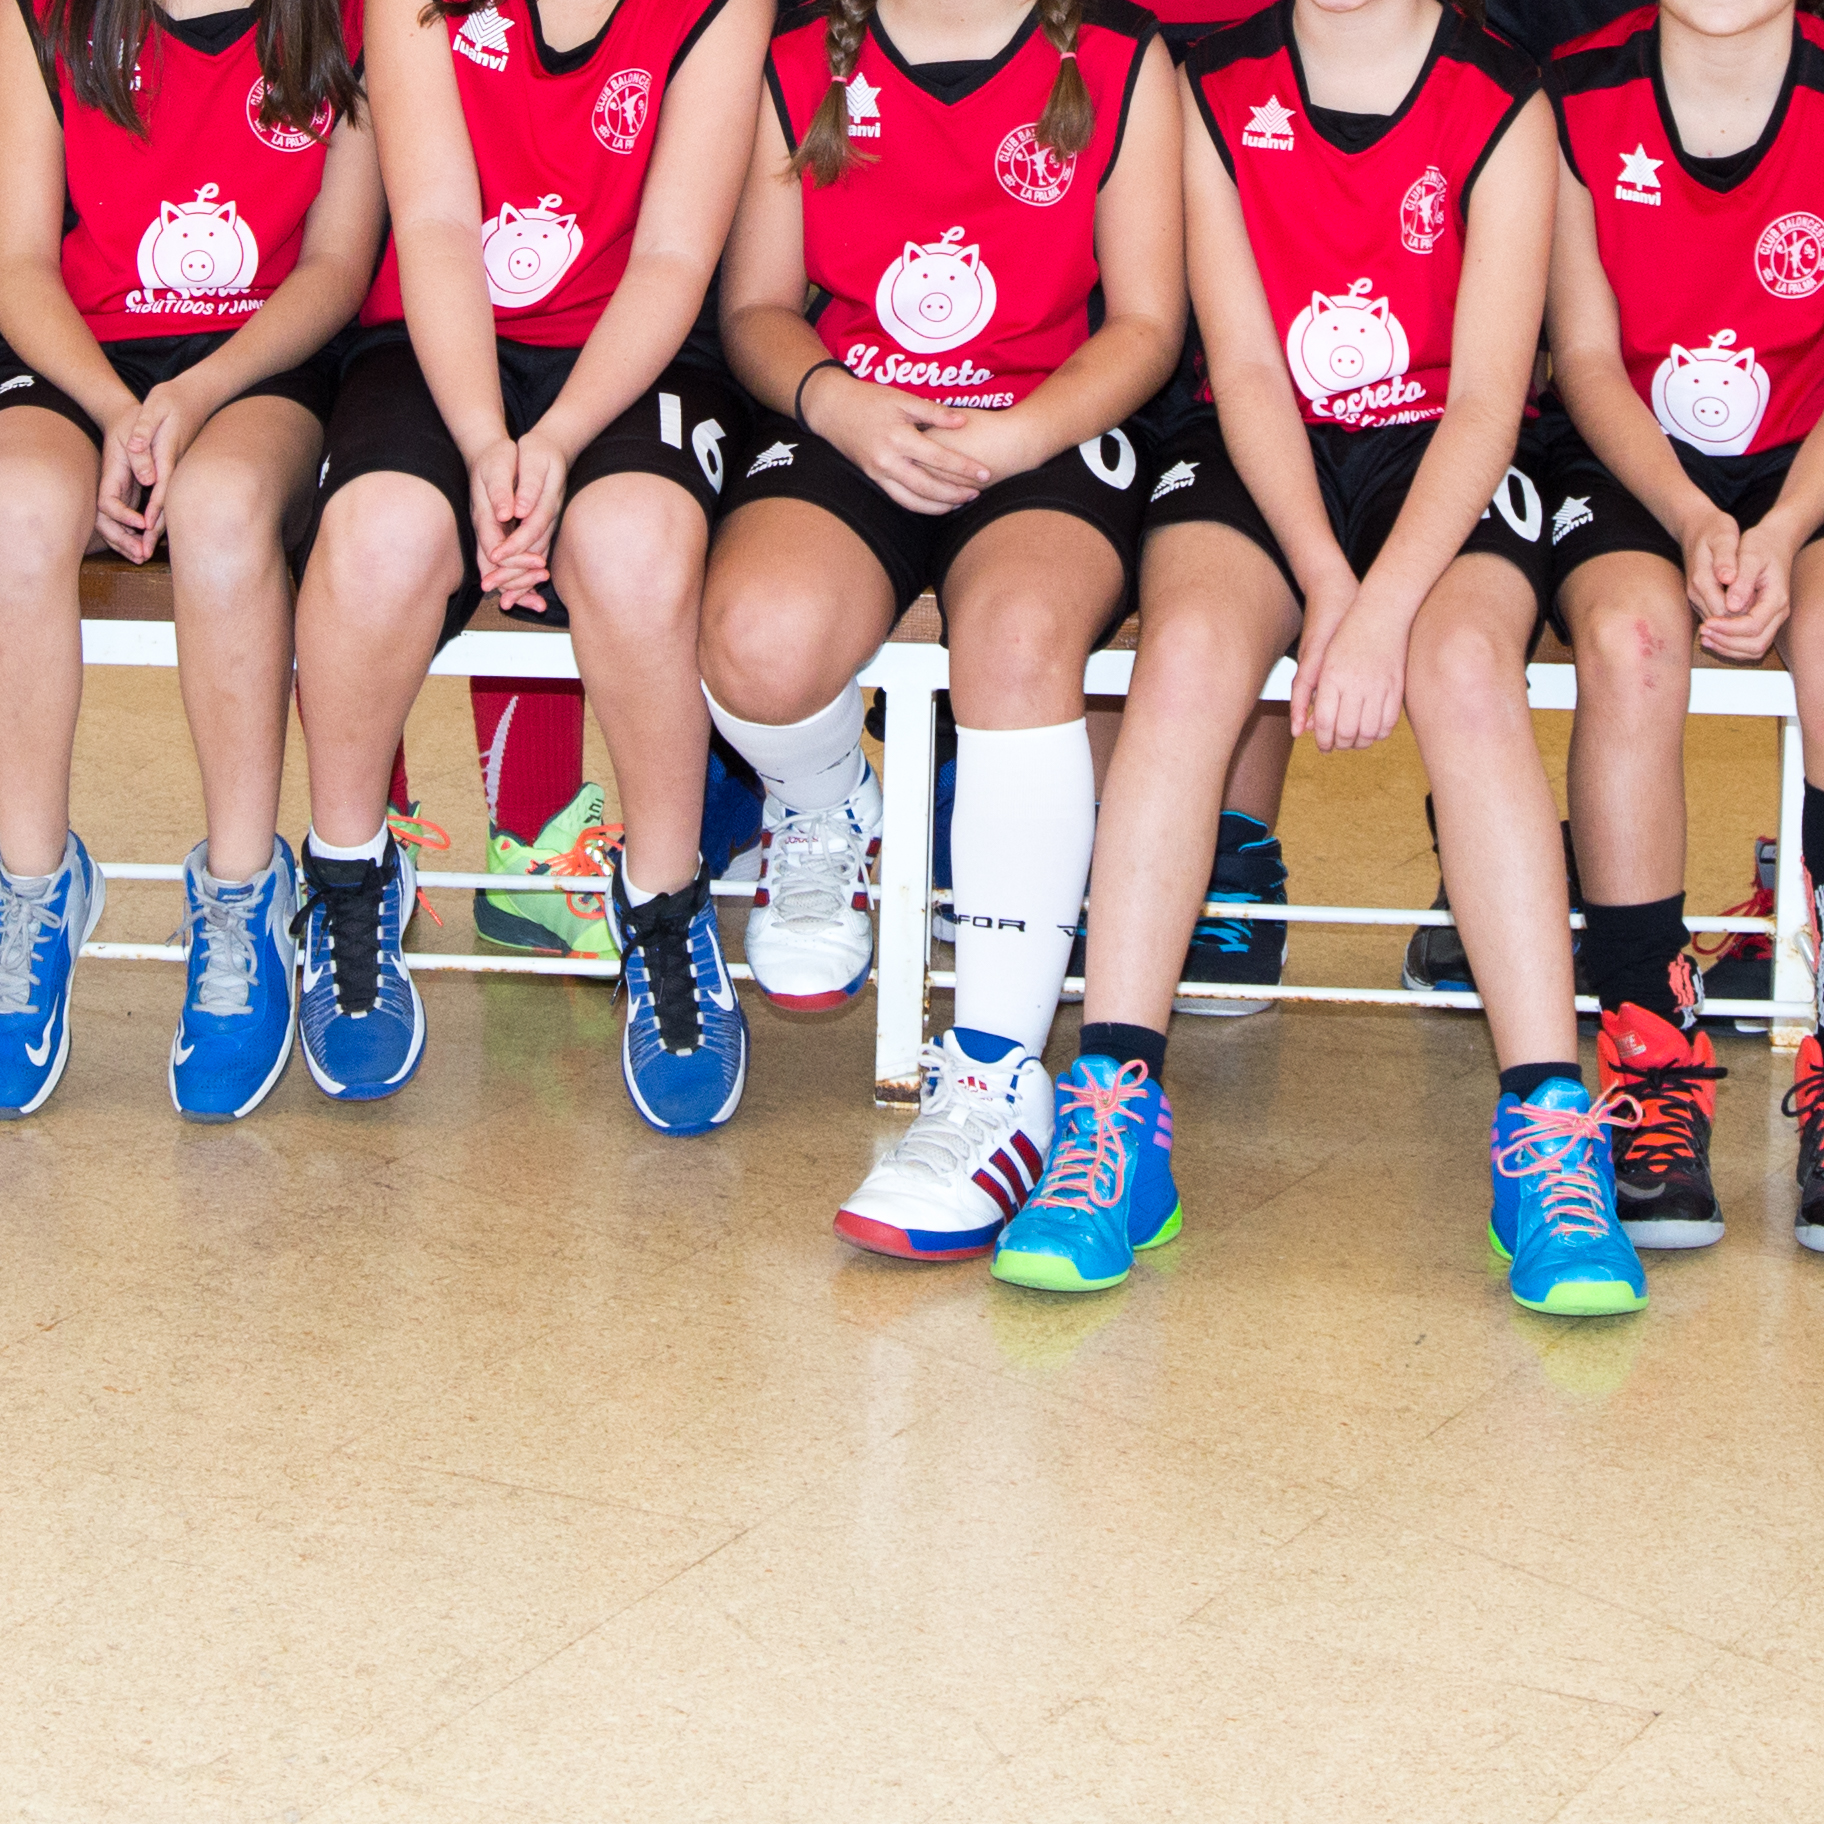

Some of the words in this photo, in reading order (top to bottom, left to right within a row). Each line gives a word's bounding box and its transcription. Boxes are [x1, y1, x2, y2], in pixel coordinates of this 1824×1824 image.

[452, 34, 508, 73] luanvi
[595, 86, 613, 113] CLUB
[848, 122, 881, 138] anvi
[271, 133, 284, 147] LA
[285, 134, 312, 148] PALM
[611, 136, 624, 149] LA
[998, 136, 1019, 163] CLUB
[1242, 132, 1294, 151] luanvi
[1020, 186, 1033, 201] LA
[1033, 186, 1061, 202] PALMA
[1616, 185, 1661, 206] luanvi
[1408, 236, 1419, 249] LA
[1759, 228, 1780, 256] CLUB
[1775, 281, 1787, 293] LA
[1787, 277, 1817, 294] PALMA
[844, 343, 879, 378] El
[874, 353, 994, 387] Secreto
[658, 392, 726, 495] 16
